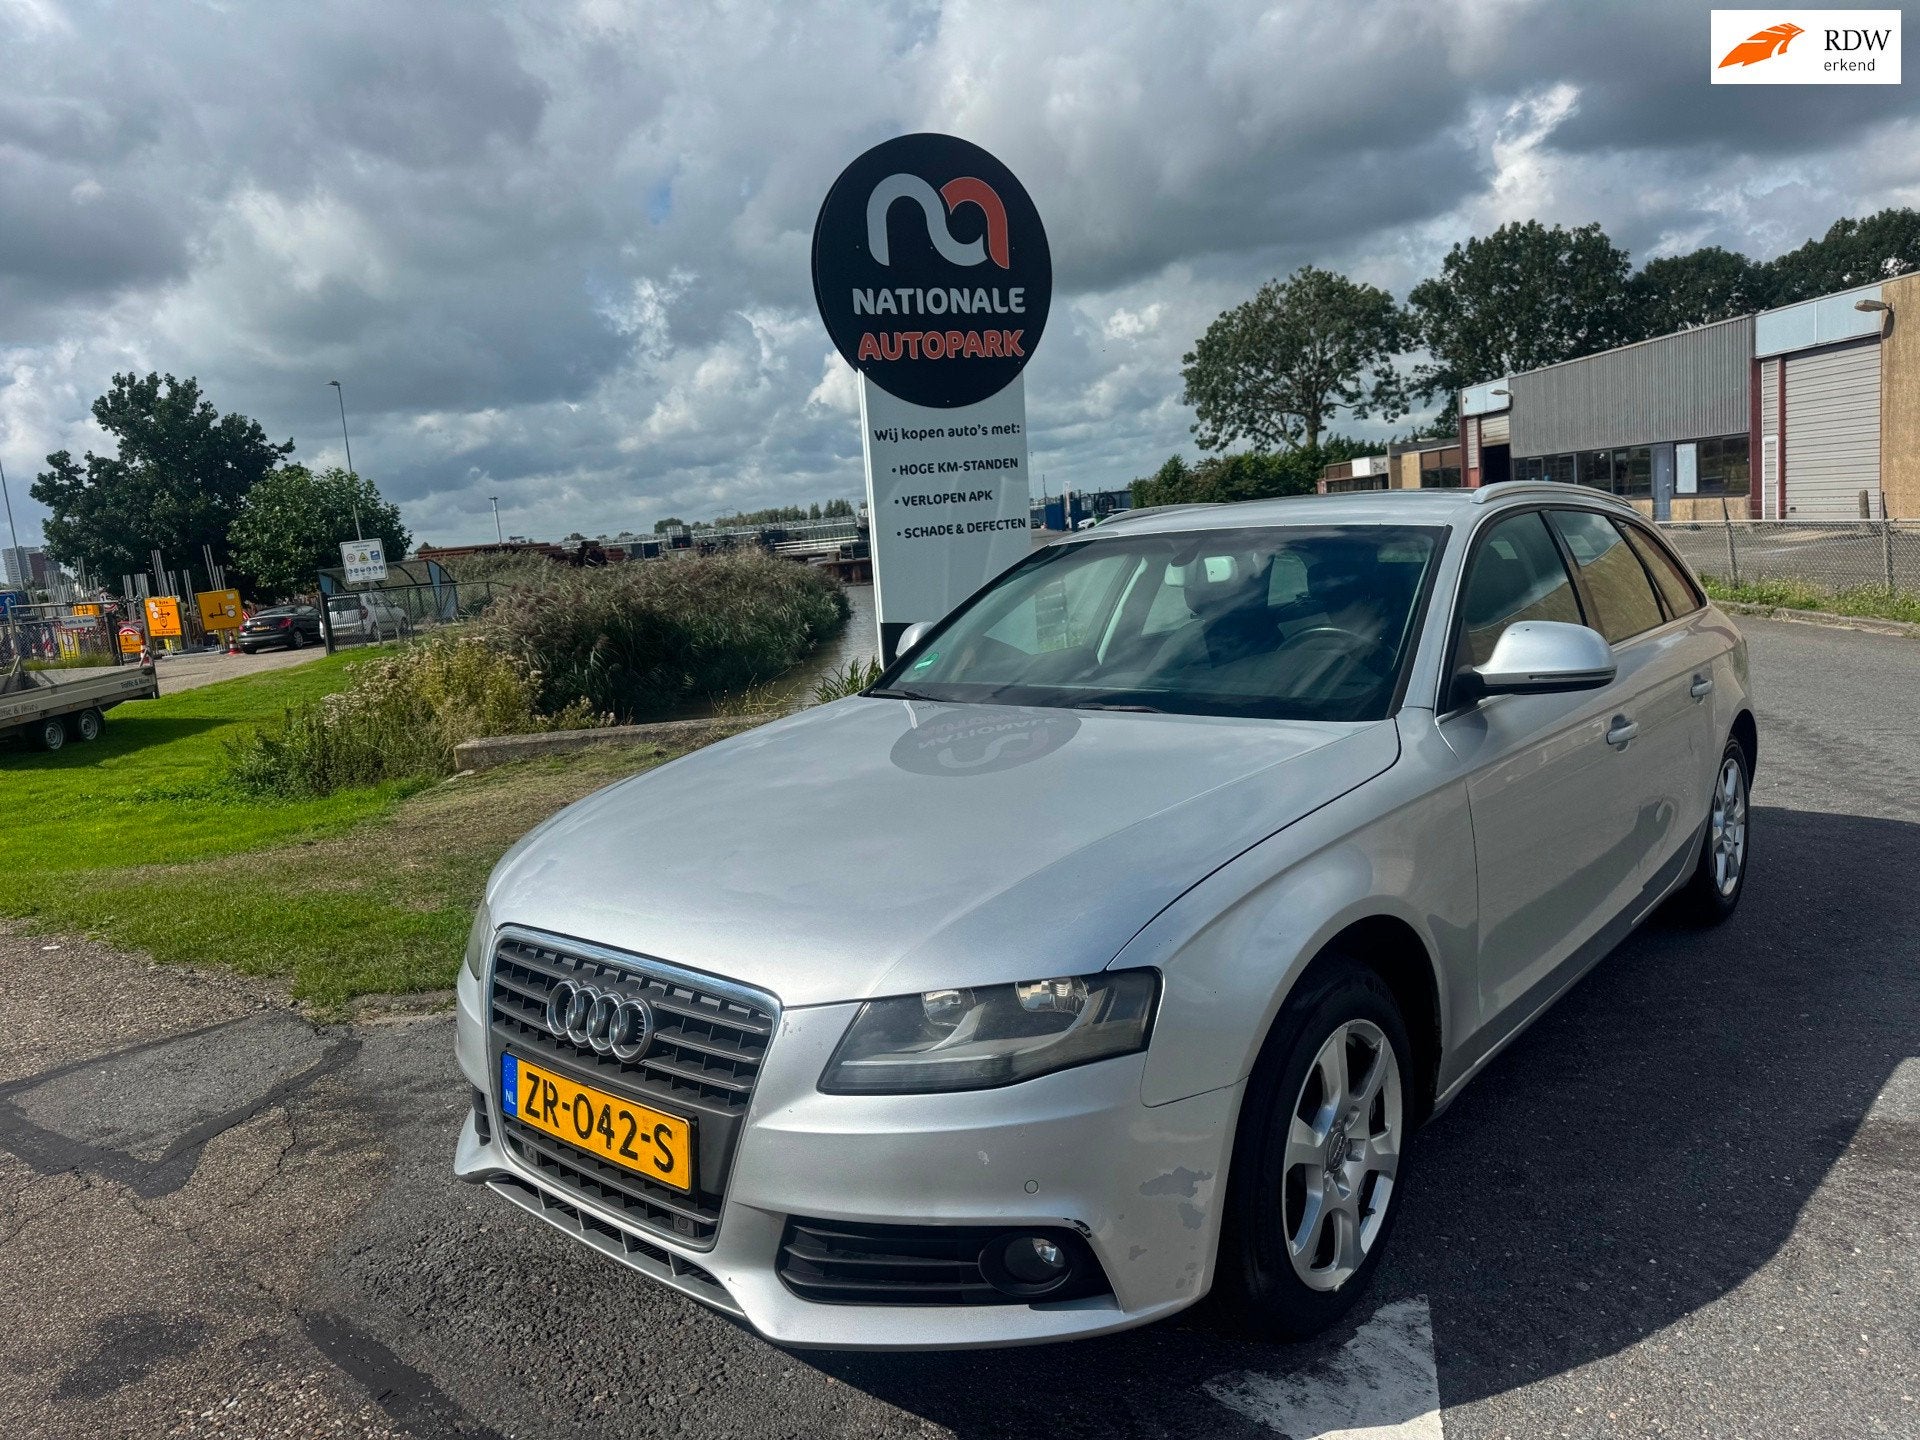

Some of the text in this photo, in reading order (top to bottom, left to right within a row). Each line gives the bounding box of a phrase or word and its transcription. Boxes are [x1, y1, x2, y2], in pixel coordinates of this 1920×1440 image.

[852, 287, 1026, 316] NATIONALE
[857, 329, 1025, 361] AUTOPARK
[874, 422, 1021, 443] Wij kopen auto's met:
[899, 457, 1019, 476] HOGE KM-STANDEN
[901, 490, 993, 507] VERLOPEN APK
[904, 517, 1027, 539] SCHADE & DEFECTEN
[505, 1089, 516, 1106] NL
[525, 1071, 675, 1174] ZR-042-S
